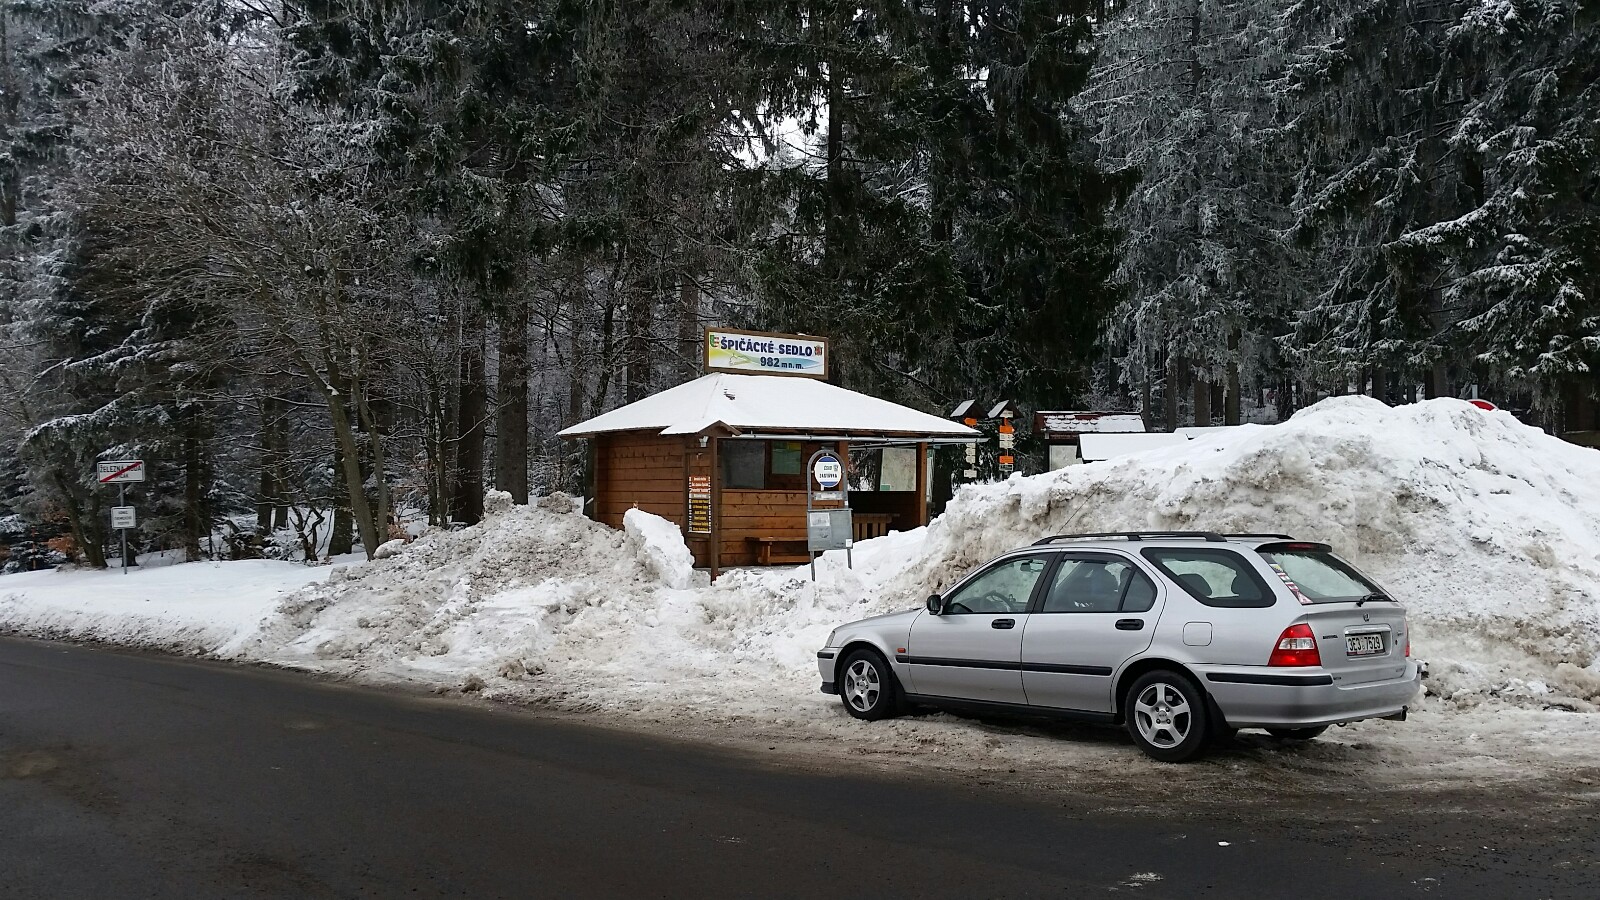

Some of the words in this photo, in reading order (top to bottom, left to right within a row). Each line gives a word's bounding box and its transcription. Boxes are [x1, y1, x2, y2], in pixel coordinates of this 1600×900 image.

[721, 336, 774, 353] ŠPIČÁCKÉ
[779, 344, 812, 356] SEDLO
[760, 357, 780, 367] 982
[1348, 638, 1361, 651] 3E3
[1364, 636, 1380, 649] 7529
